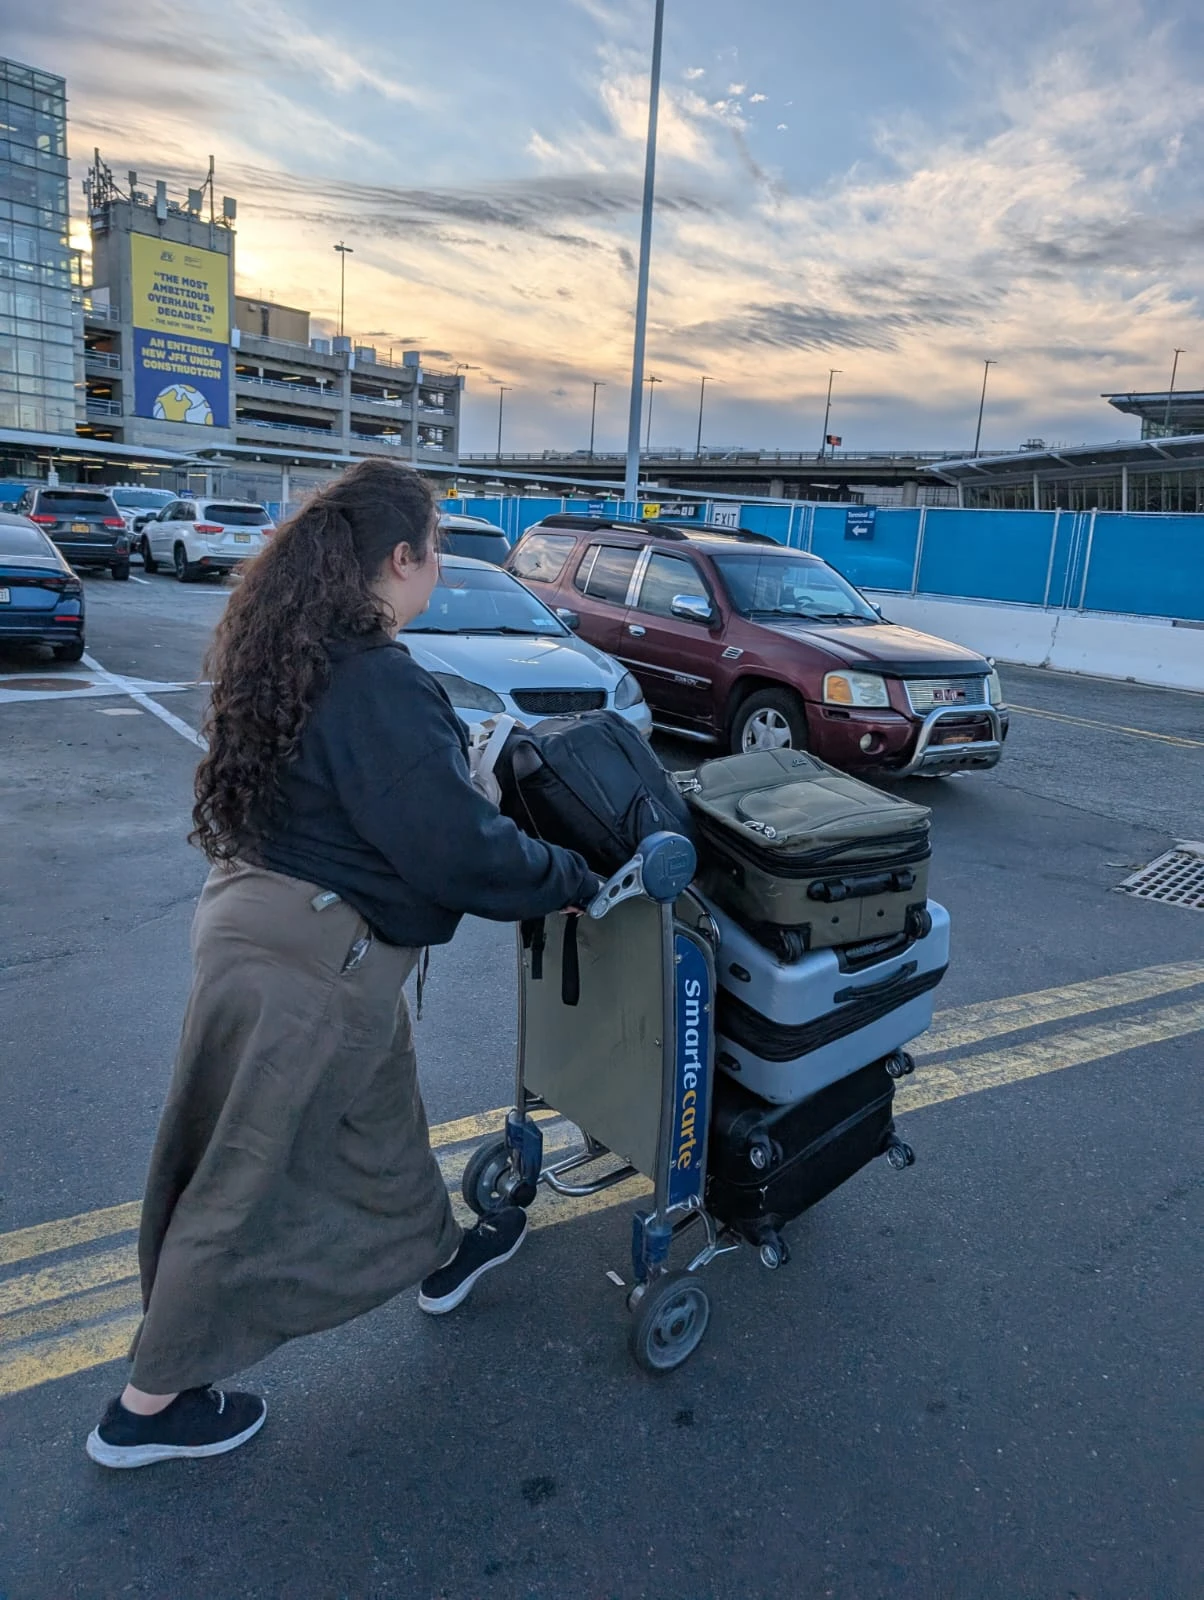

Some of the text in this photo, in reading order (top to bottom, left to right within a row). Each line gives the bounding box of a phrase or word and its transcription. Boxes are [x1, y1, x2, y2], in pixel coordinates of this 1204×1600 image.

[153, 283, 210, 302] AMBITIOUS
[182, 277, 208, 290] MOST
[147, 293, 215, 314] OVERHAUL IN
[150, 337, 214, 356] AN ENTIRELY
[141, 347, 222, 369] NEW JFK UNDER
[143, 359, 221, 379] CONSTRUCTION
[715, 513, 737, 526] EXIT
